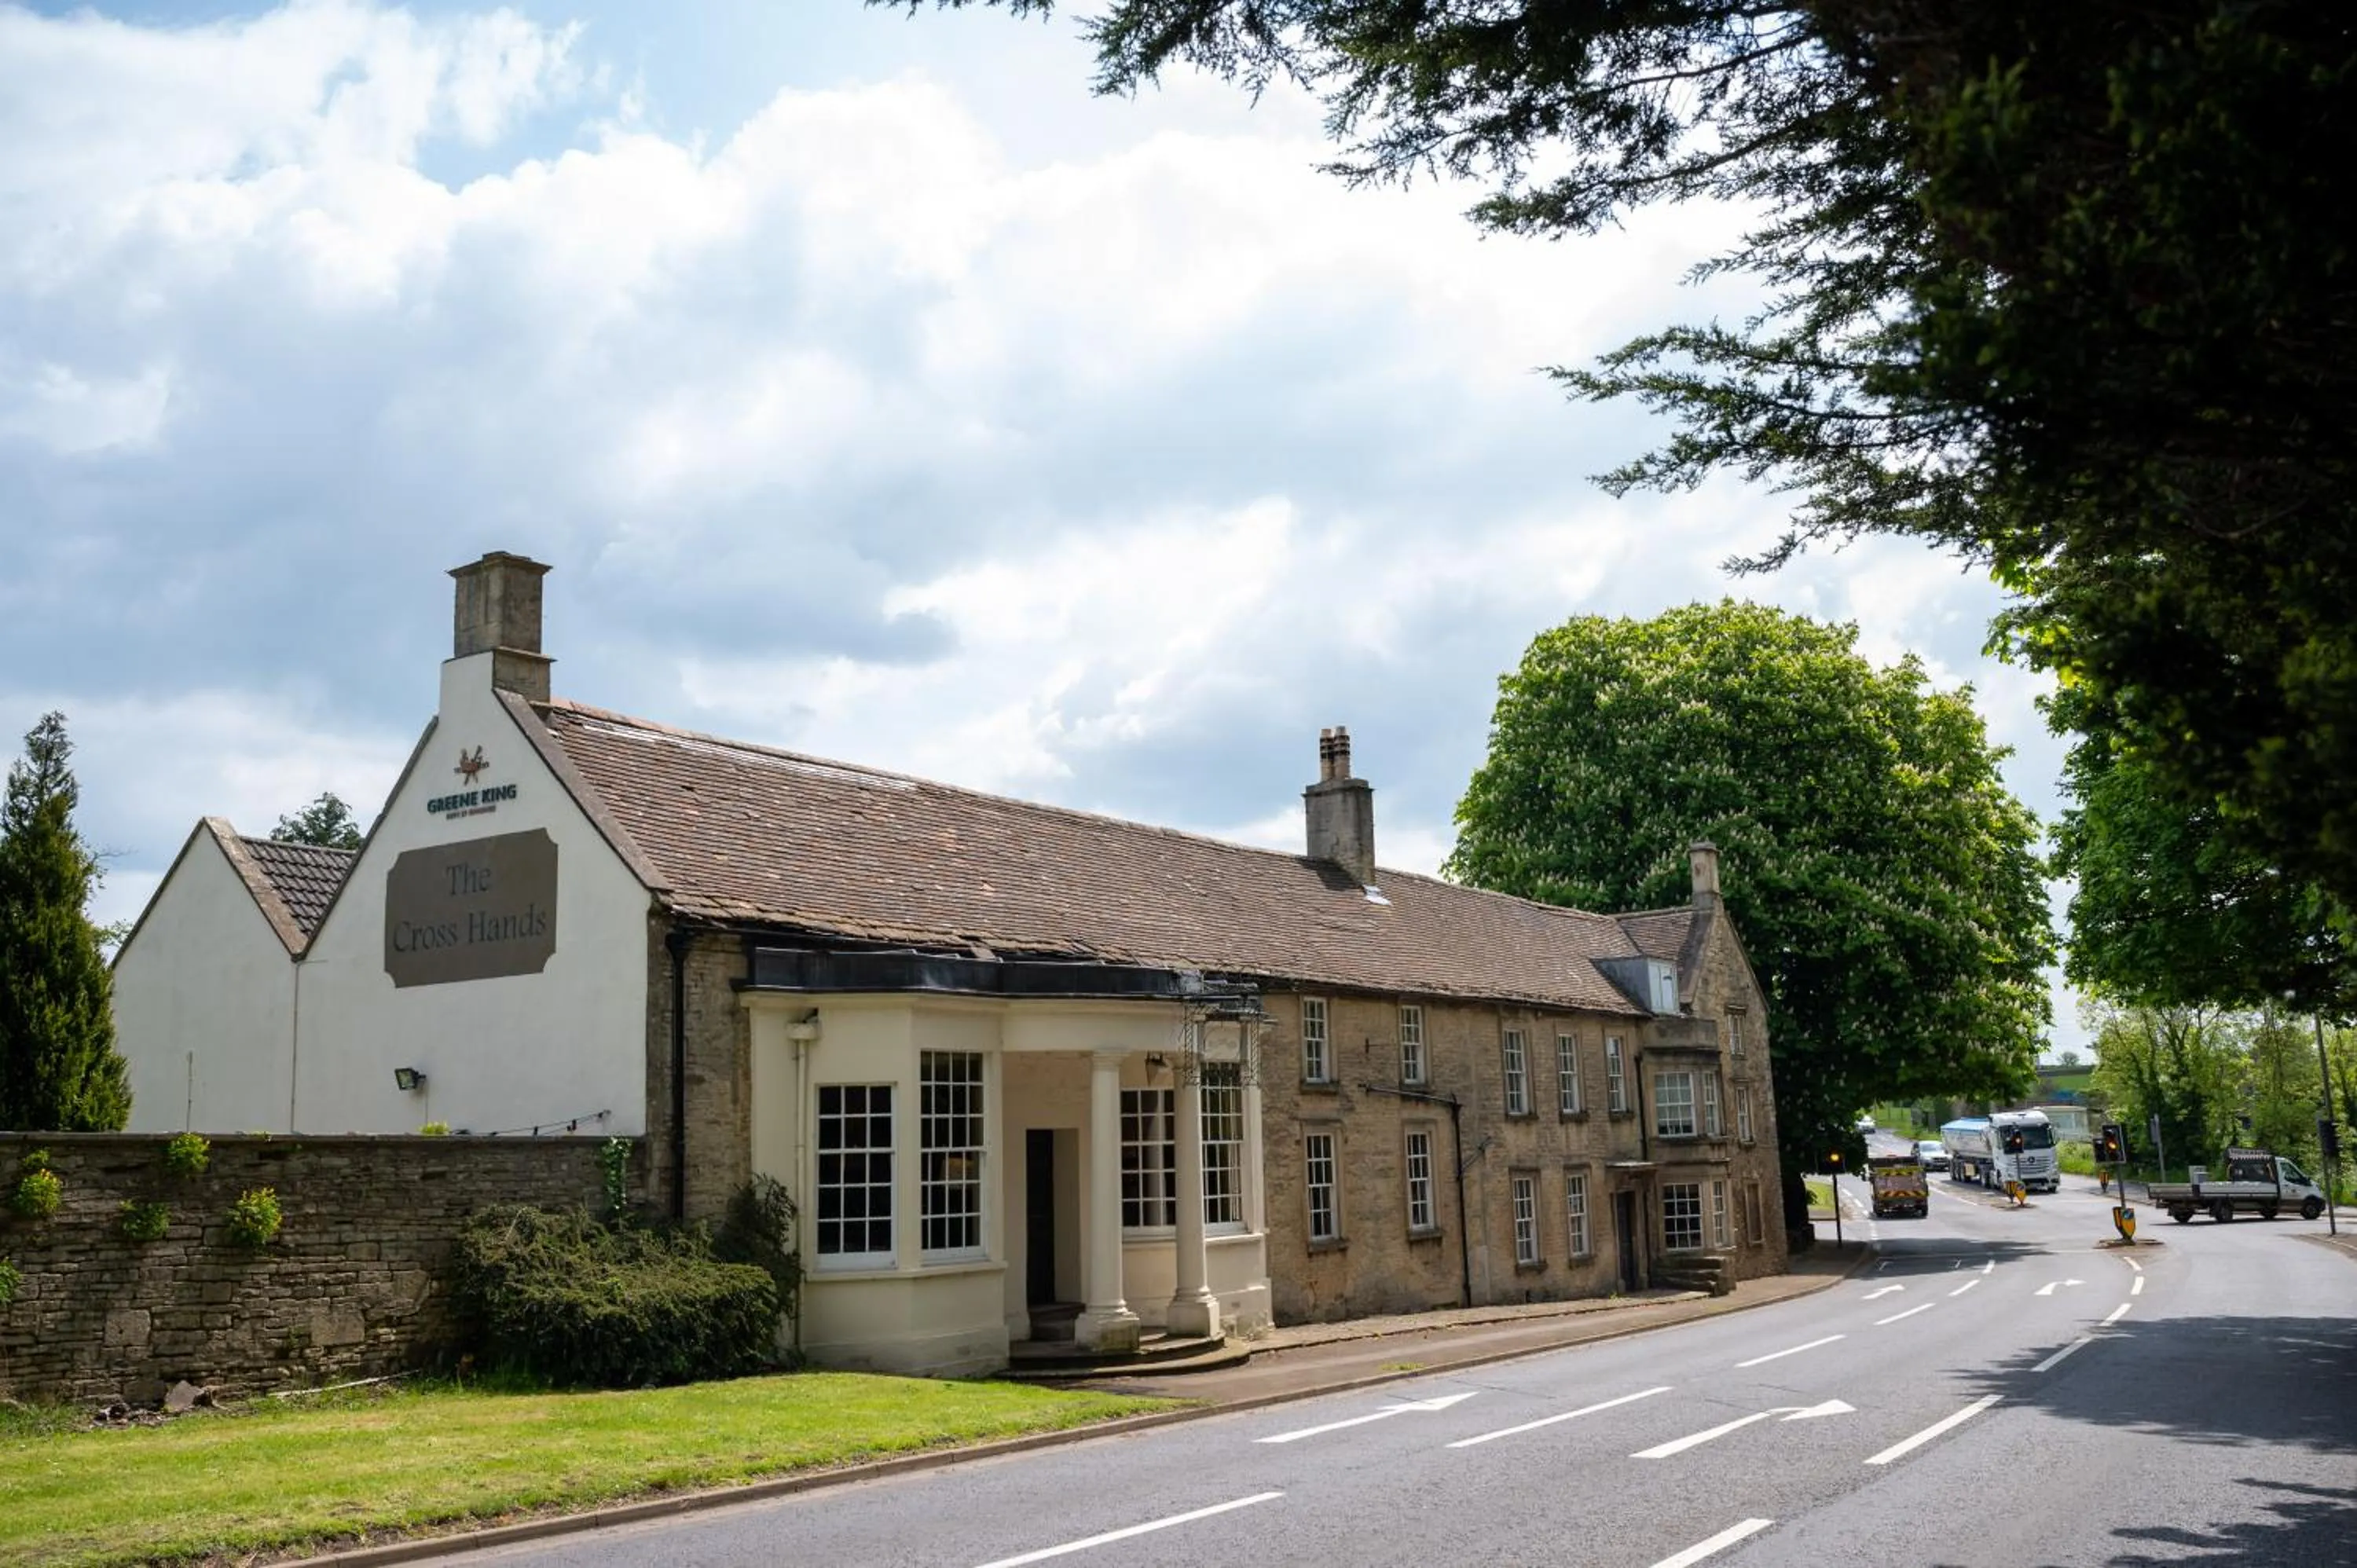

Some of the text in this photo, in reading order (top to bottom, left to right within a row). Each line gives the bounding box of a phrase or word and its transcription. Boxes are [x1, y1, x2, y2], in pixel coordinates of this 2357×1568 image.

[427, 791, 478, 814] GREENE
[482, 784, 516, 804] KING
[445, 862, 491, 896] The
[393, 903, 546, 952] Cross Hands
